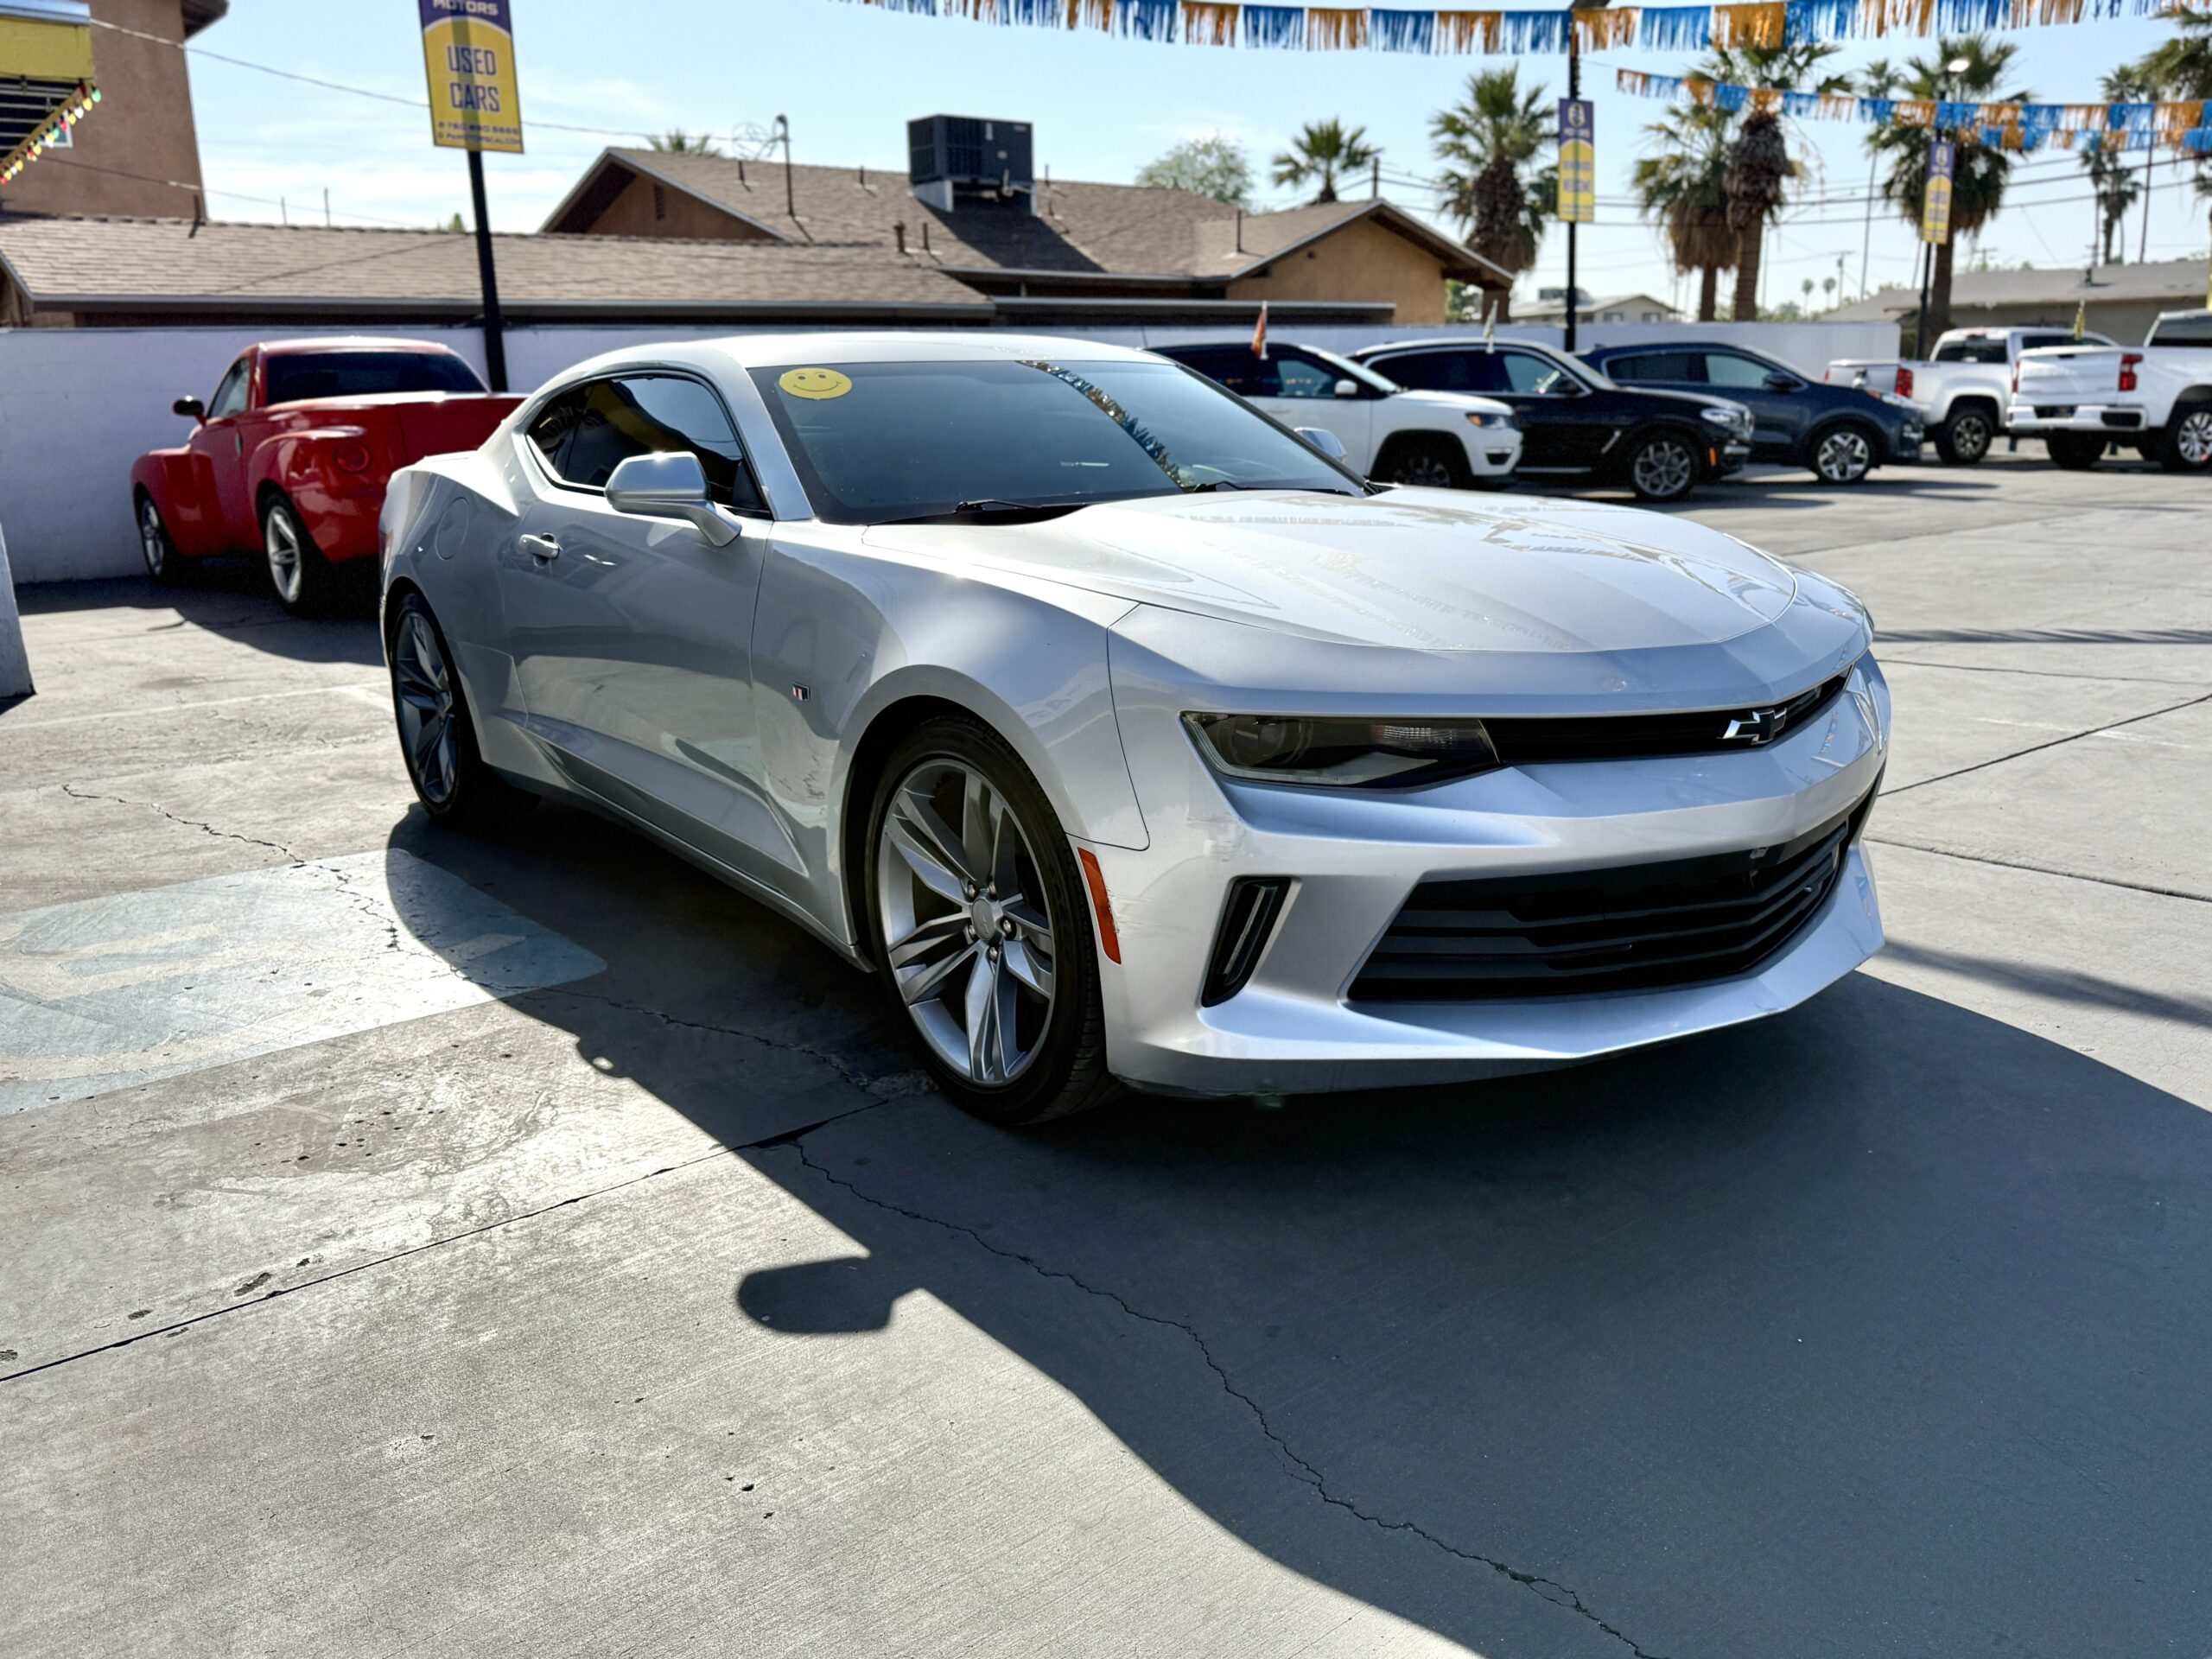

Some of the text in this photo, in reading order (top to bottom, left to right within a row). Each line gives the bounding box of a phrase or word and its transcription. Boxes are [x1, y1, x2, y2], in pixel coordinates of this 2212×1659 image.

[433, 0, 499, 16] MOTORS
[448, 46, 497, 76] USED
[450, 83, 500, 112] CARS
